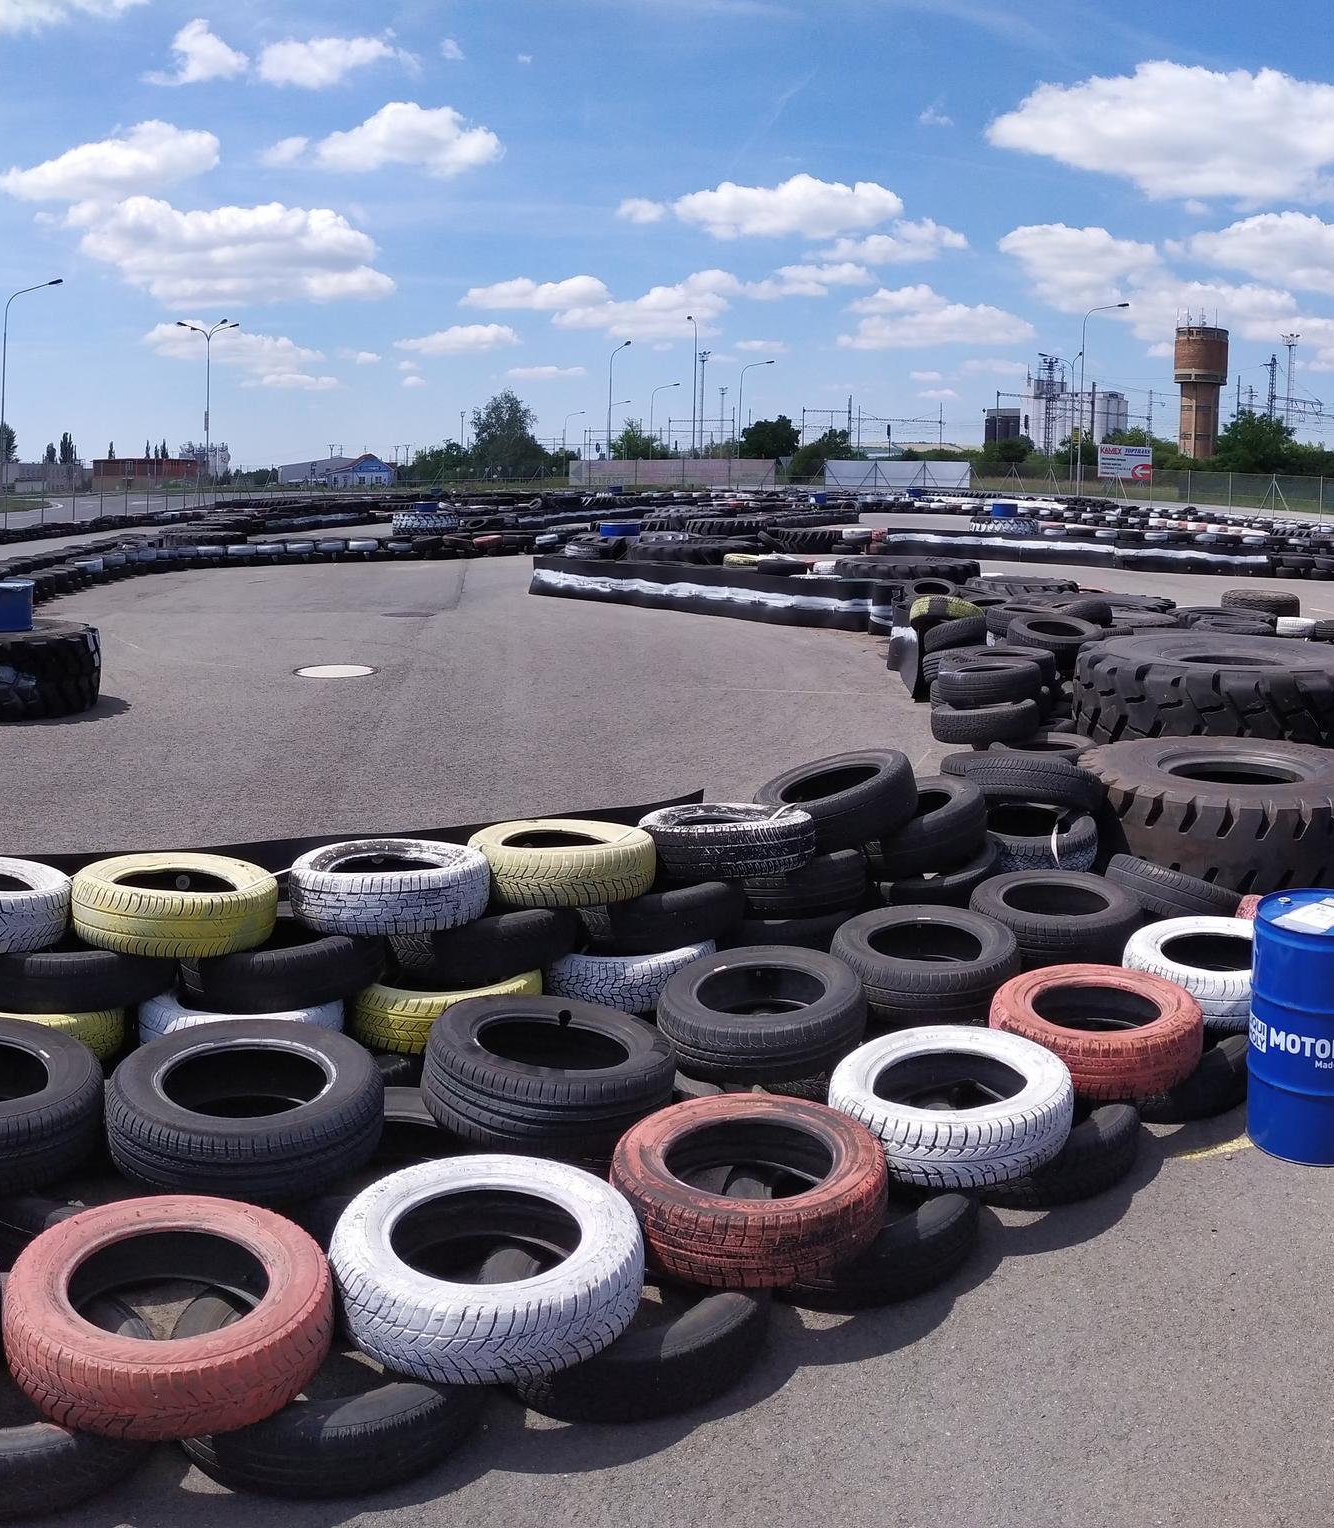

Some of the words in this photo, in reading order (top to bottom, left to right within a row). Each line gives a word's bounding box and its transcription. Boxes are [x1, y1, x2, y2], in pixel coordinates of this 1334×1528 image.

[1100, 446, 1122, 455] KAMEX
[1250, 1015, 1266, 1036] QUI
[1250, 1029, 1266, 1050] OLY
